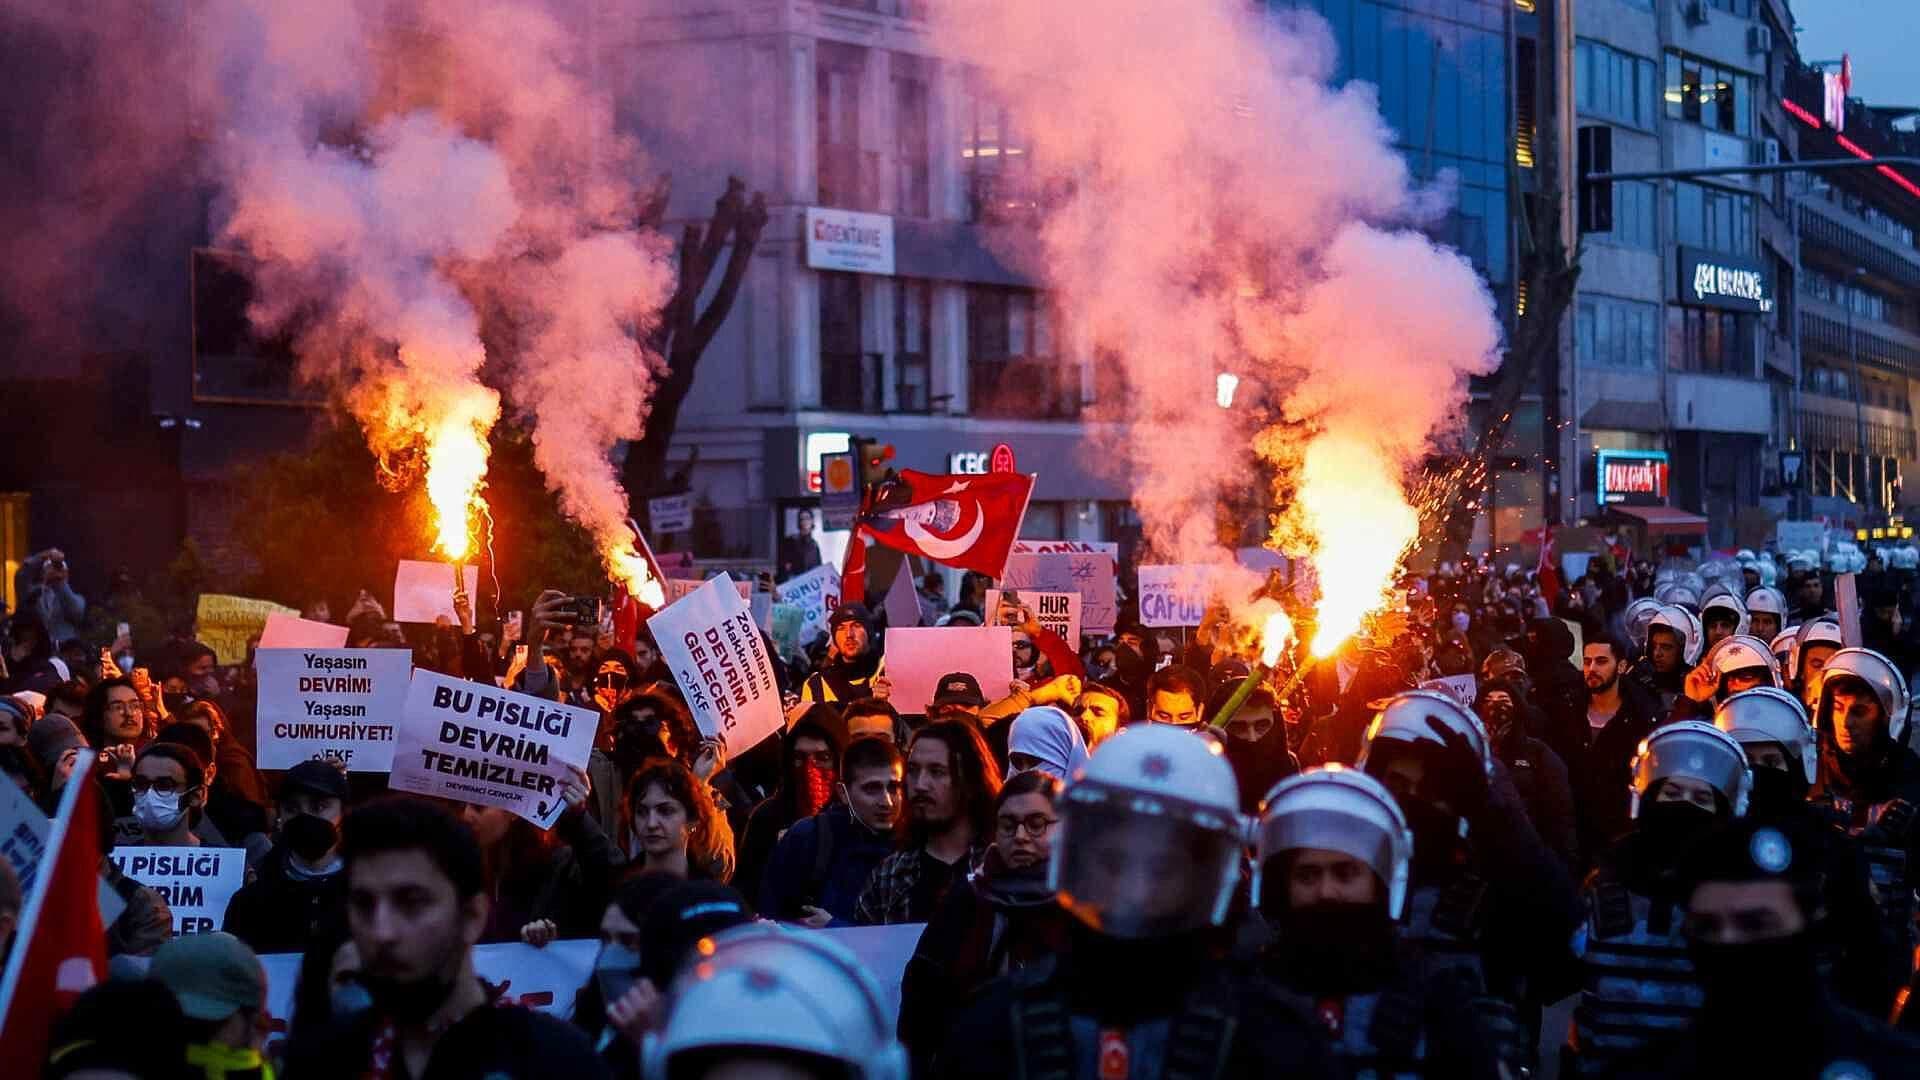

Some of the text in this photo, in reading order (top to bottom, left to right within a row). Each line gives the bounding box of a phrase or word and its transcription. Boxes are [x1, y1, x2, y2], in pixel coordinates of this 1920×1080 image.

[1039, 595, 1069, 614] HÜR
[304, 653, 367, 673] Yaşasın
[705, 627, 747, 707] DEVRİM
[722, 619, 760, 700] Hakkından
[736, 611, 771, 690] Zorbaların
[299, 674, 371, 693] DEVRİM!
[684, 631, 737, 730] GELECEK!
[689, 682, 710, 712] FKF
[304, 700, 366, 720] Yaşasın
[433, 685, 572, 738] BU PİSLİĞİ
[274, 721, 393, 741] CUMHURİYET!
[439, 721, 549, 765] DEVRİM
[422, 749, 556, 797] TEMİZLER
[131, 853, 220, 876] PİSLİĞİ
